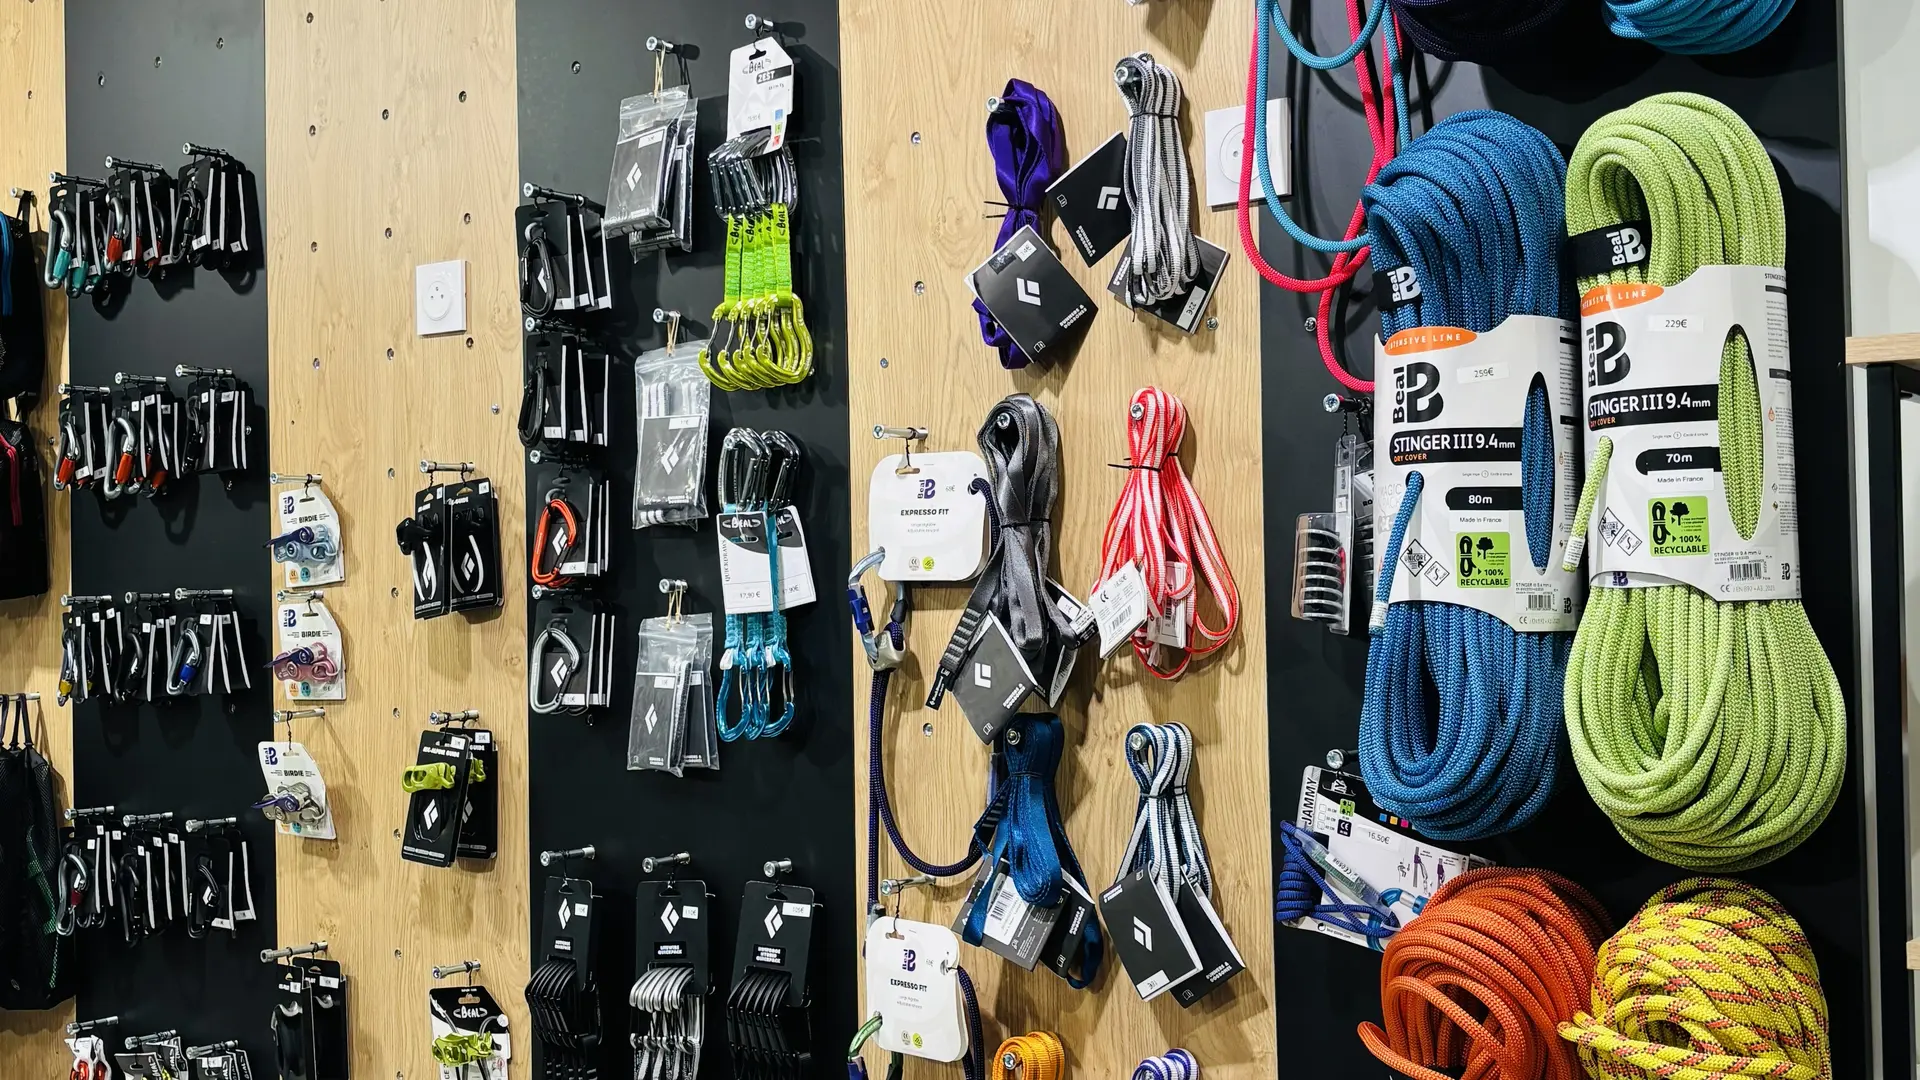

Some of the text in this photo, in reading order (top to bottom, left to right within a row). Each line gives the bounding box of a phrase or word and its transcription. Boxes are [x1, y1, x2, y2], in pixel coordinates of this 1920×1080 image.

[1606, 231, 1626, 265] Beal
[1387, 270, 1402, 302] Beal
[1618, 289, 1647, 300] LINE
[1665, 318, 1688, 329] 229€
[1433, 333, 1461, 342] LINE
[1586, 327, 1596, 388] Beal
[1474, 367, 1495, 379] 259€
[1393, 366, 1405, 424] Beal
[1589, 396, 1640, 418] STINGER
[1641, 393, 1664, 411] III
[1598, 417, 1616, 426] COVER
[1393, 434, 1451, 454] STINGER
[1453, 433, 1475, 449] III
[1393, 453, 1428, 463] DRY COVER
[1666, 453, 1693, 463] 70m
[917, 479, 925, 499] Beal
[1468, 494, 1493, 504] 80m
[900, 508, 949, 517] EXPRESSO FIT
[298, 515, 318, 524] BIRDIE
[731, 516, 753, 528] BEAL
[1679, 535, 1702, 543] 100%
[1654, 544, 1707, 555] RECYCLABLE
[722, 539, 731, 582] QUICKDRAWS
[1484, 568, 1504, 576] 100%
[1460, 578, 1509, 586] RECYCLABLE
[301, 630, 322, 638] BIRDIE
[1301, 777, 1317, 826] JAMMY
[890, 978, 928, 992] EXPRESSO FIT
[462, 1005, 480, 1019] BEAL
